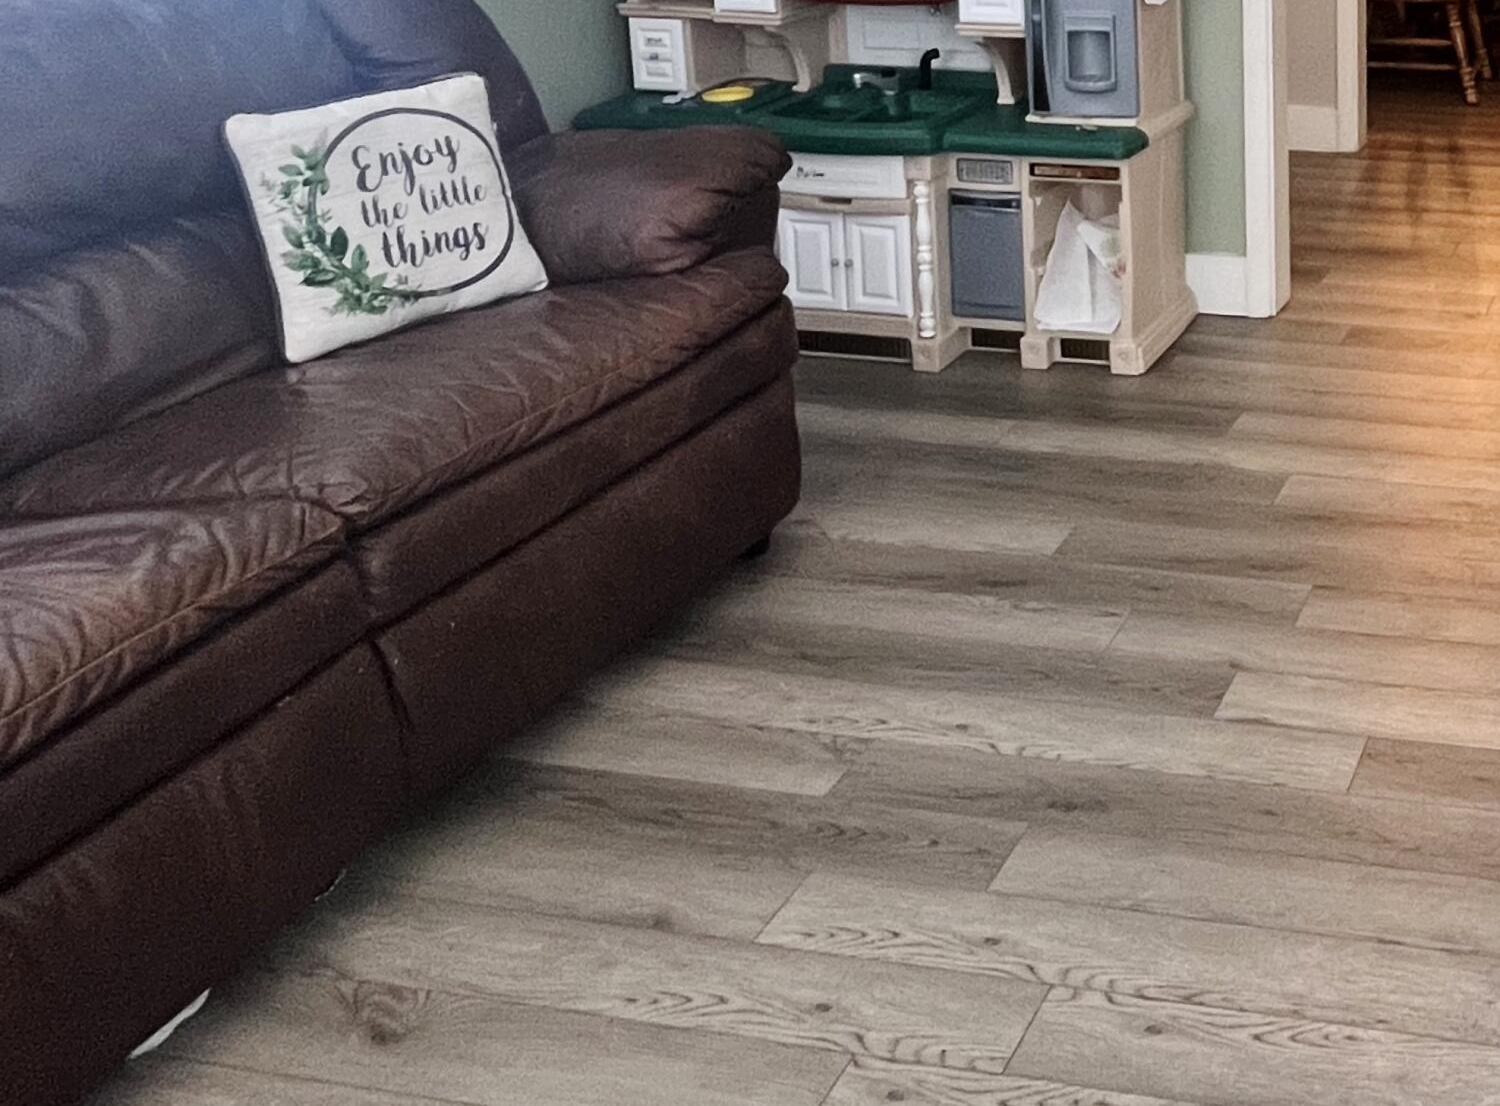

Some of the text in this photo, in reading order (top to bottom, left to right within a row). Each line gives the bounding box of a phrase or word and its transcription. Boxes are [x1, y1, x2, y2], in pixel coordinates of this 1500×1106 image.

[351, 135, 459, 195] Enjoy
[360, 176, 488, 228] the little
[381, 222, 490, 268] things
